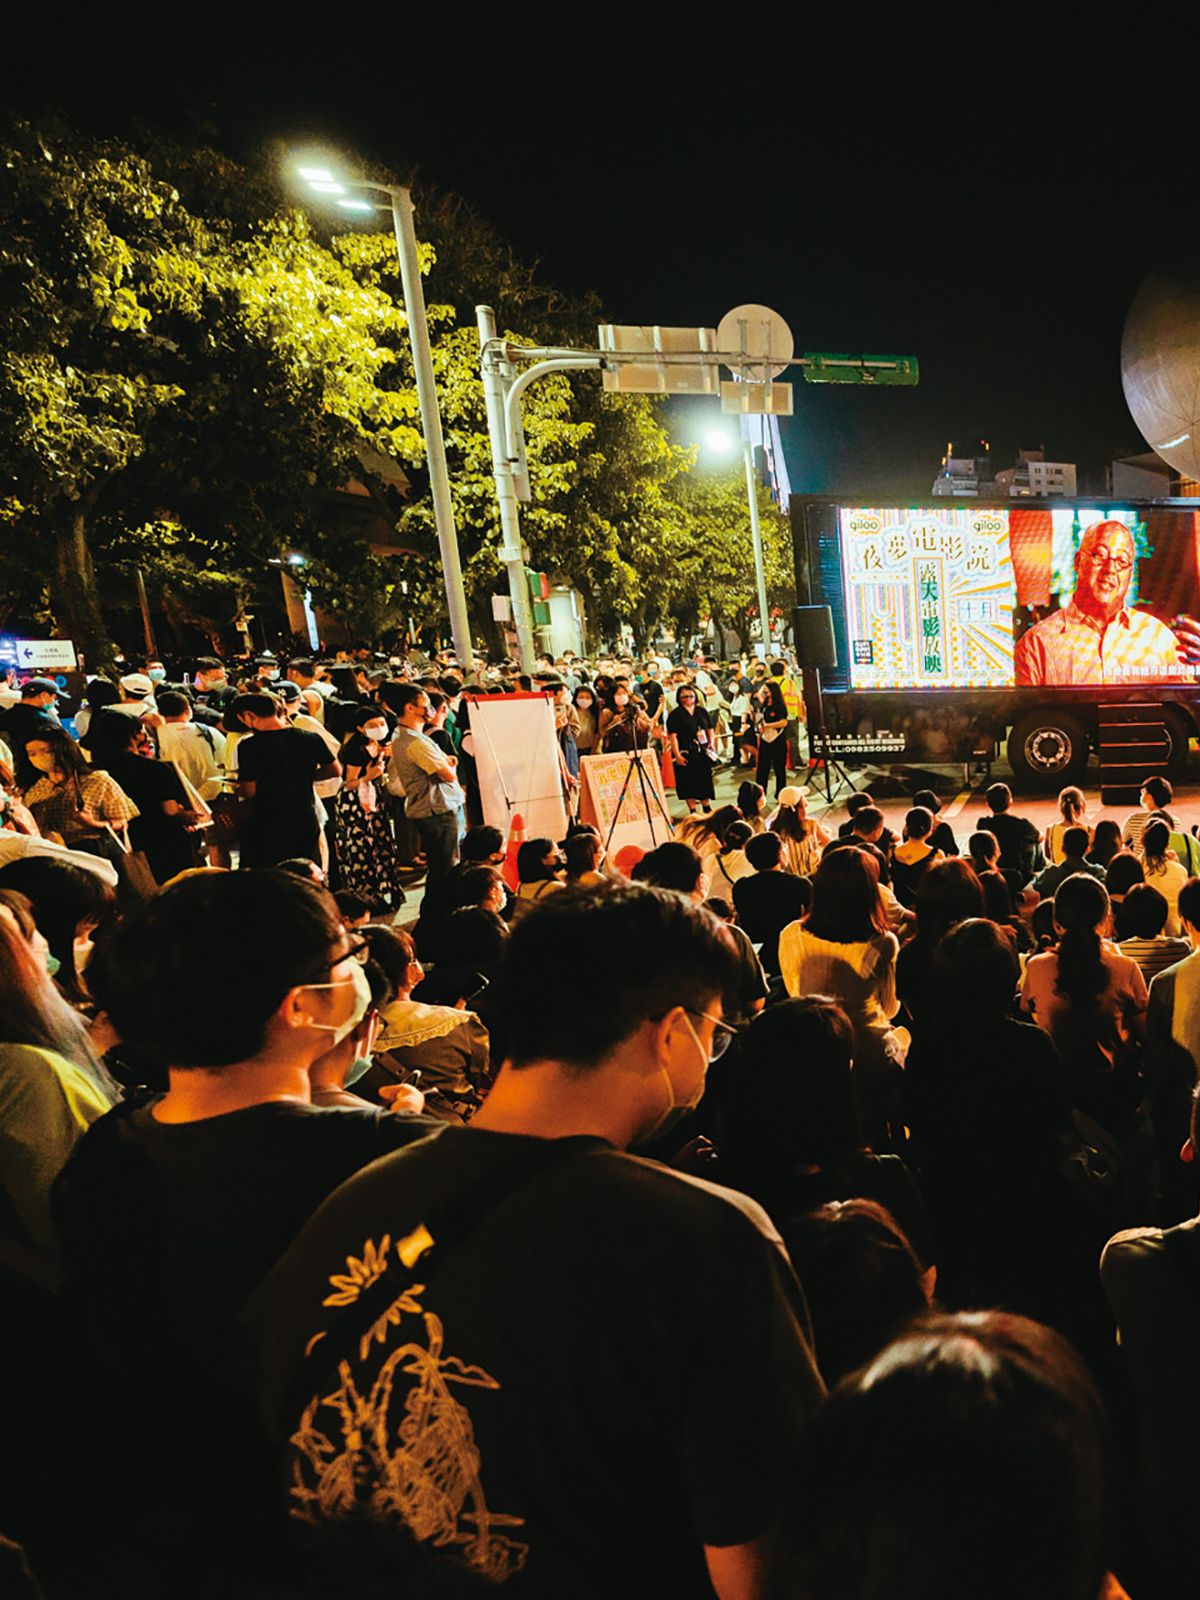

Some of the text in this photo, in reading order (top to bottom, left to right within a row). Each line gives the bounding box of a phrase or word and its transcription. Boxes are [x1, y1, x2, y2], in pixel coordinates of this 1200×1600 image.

[850, 519, 878, 532] giloo
[973, 519, 1001, 532] giloo
[814, 745, 906, 754] CLL:0982509937
